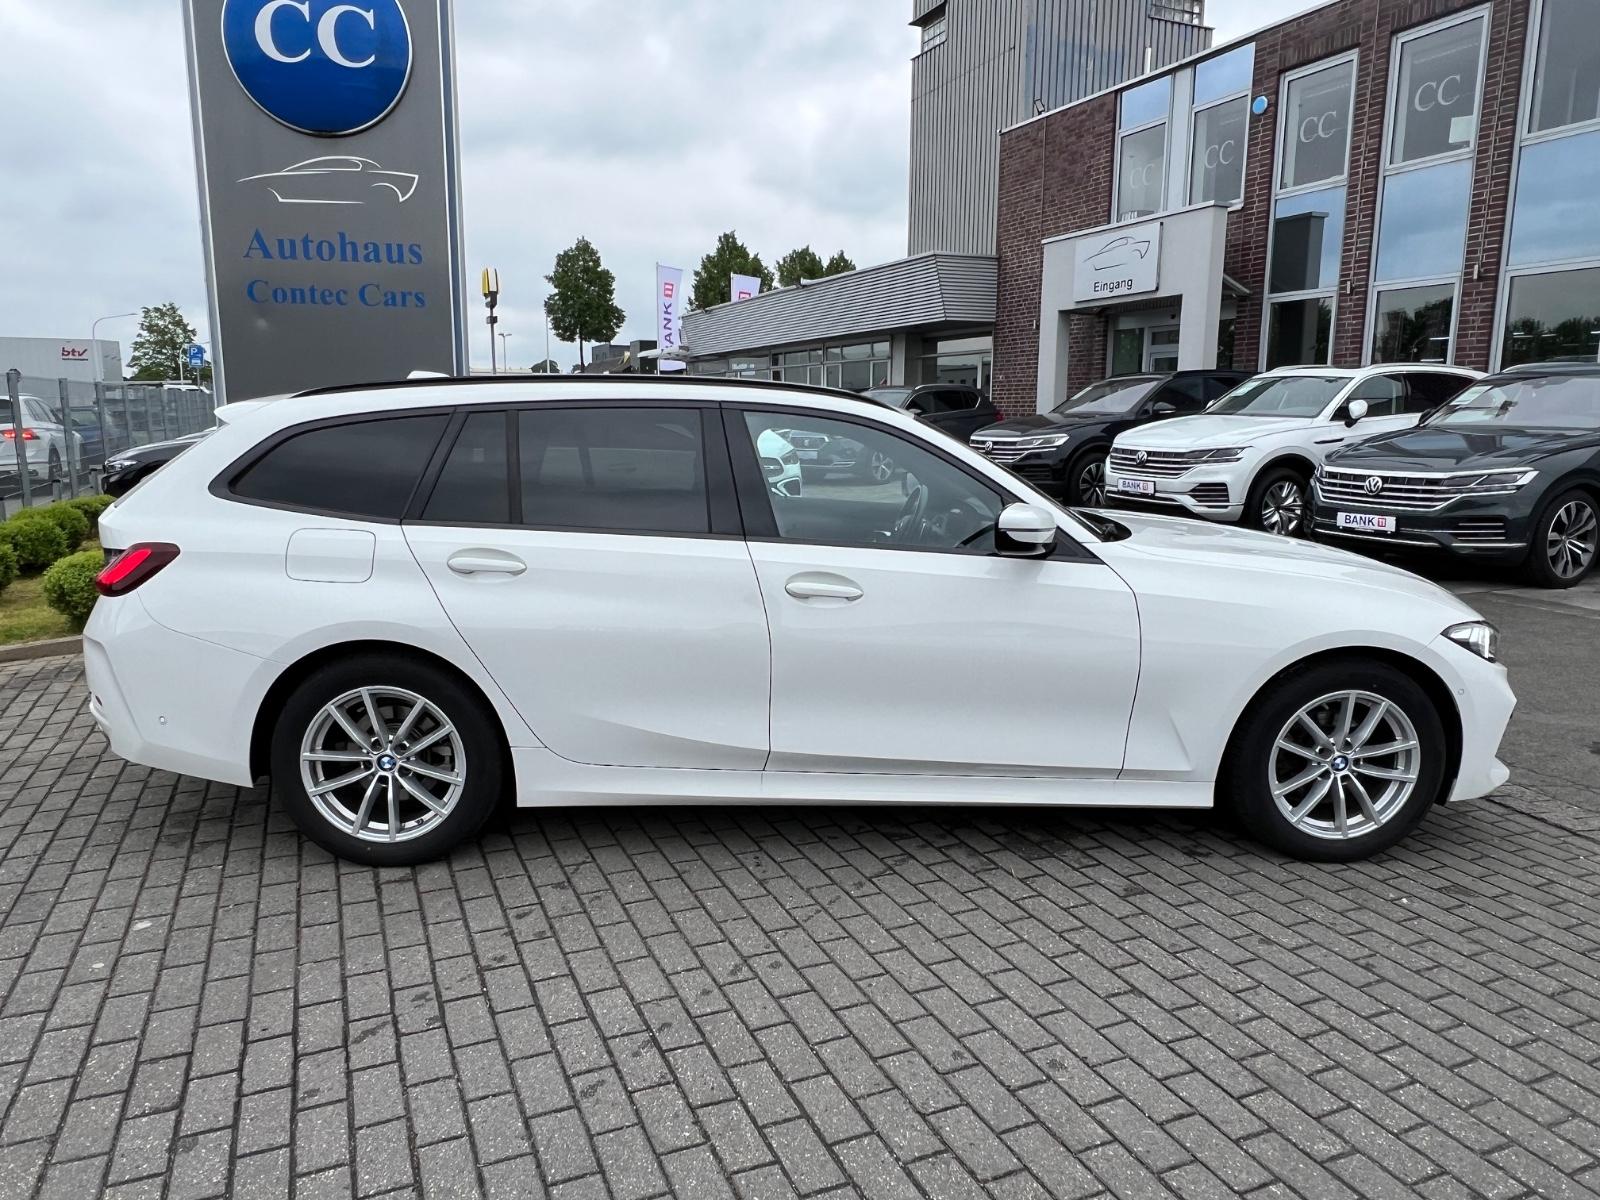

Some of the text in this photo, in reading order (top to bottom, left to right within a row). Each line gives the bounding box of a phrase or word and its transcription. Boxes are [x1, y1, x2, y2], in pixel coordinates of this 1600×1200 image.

[254, 0, 375, 68] CC
[1414, 74, 1461, 112] CC
[1300, 111, 1337, 143] CC
[1205, 140, 1235, 169] CC
[243, 228, 423, 265] Autohaus
[247, 279, 426, 308] Contec Cars
[1093, 279, 1133, 293] Eingang
[62, 347, 88, 357] btv
[1122, 480, 1141, 491] BANK
[1344, 514, 1376, 527] BANK
